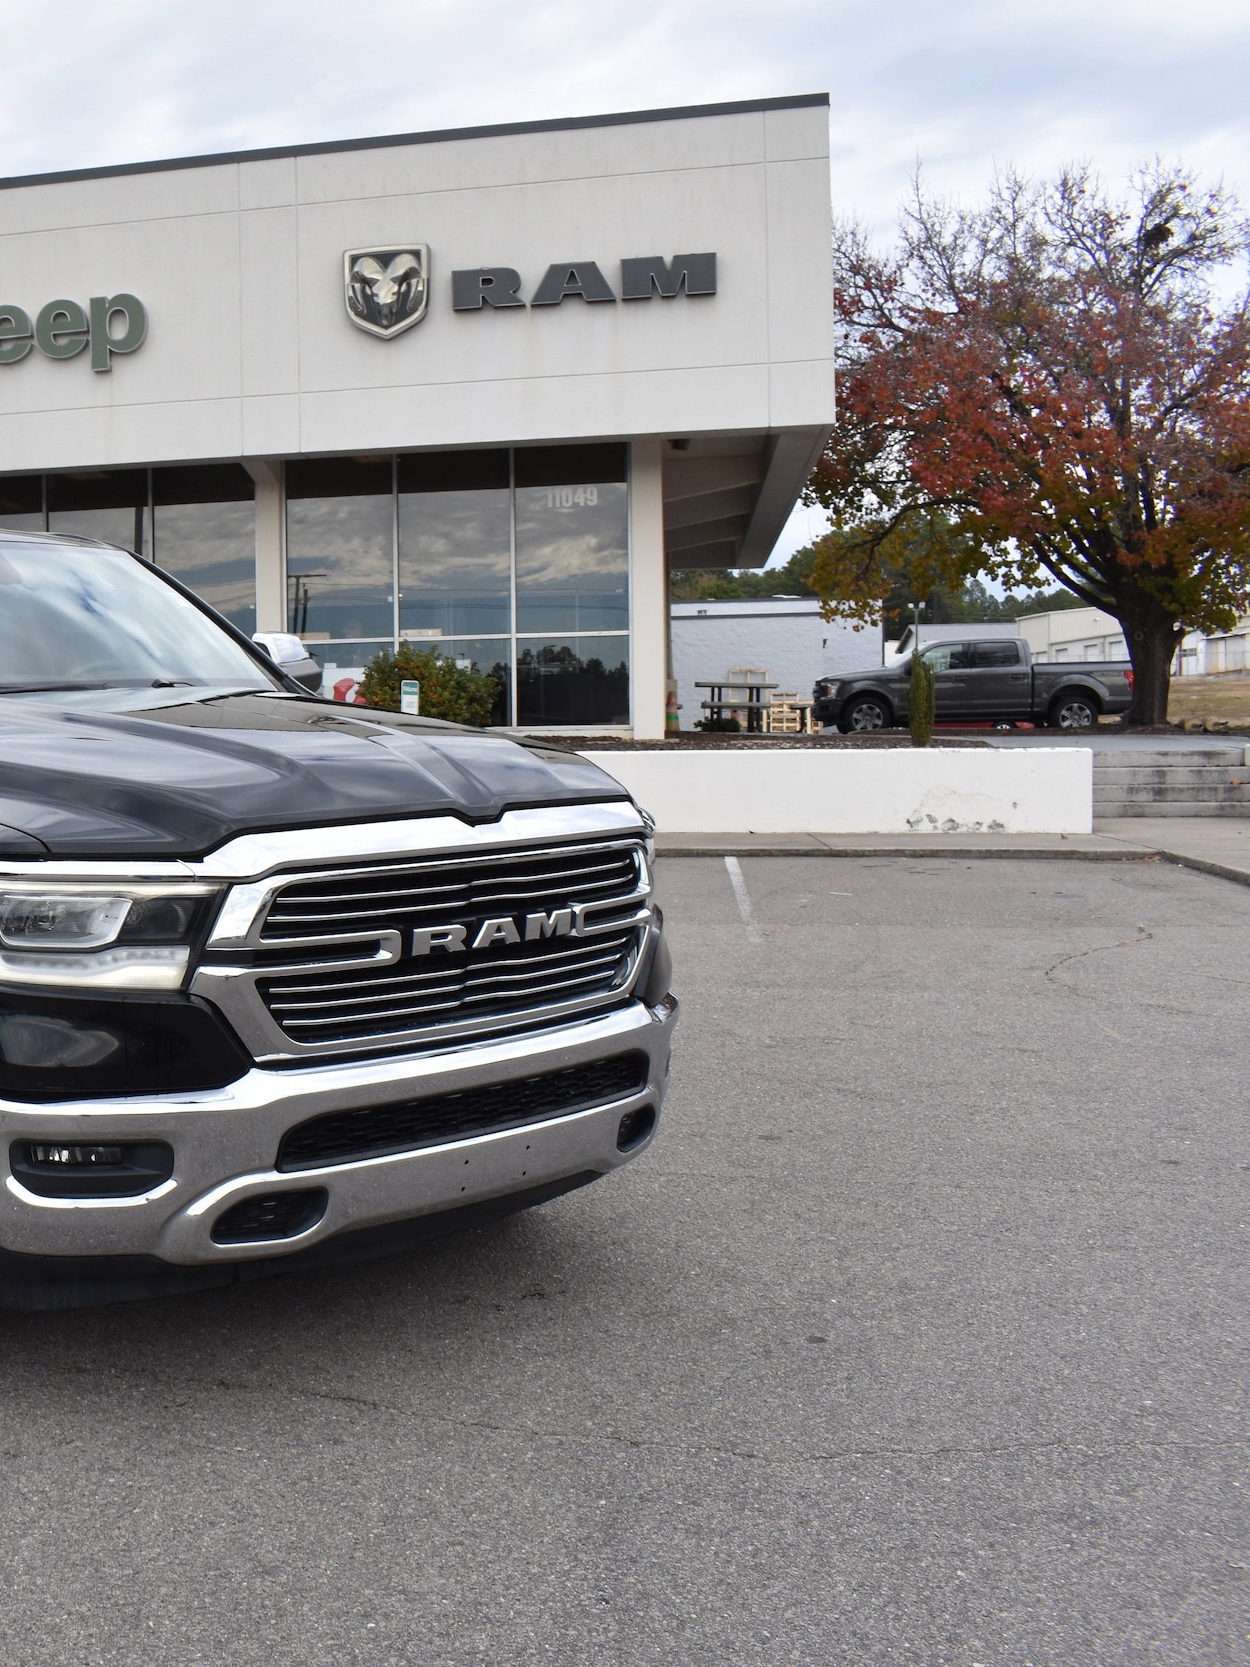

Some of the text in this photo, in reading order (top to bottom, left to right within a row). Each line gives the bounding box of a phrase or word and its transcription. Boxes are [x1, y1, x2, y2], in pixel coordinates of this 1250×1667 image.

[451, 252, 717, 312] RAM
[546, 486, 598, 508] 11049
[412, 908, 572, 957] RAM
